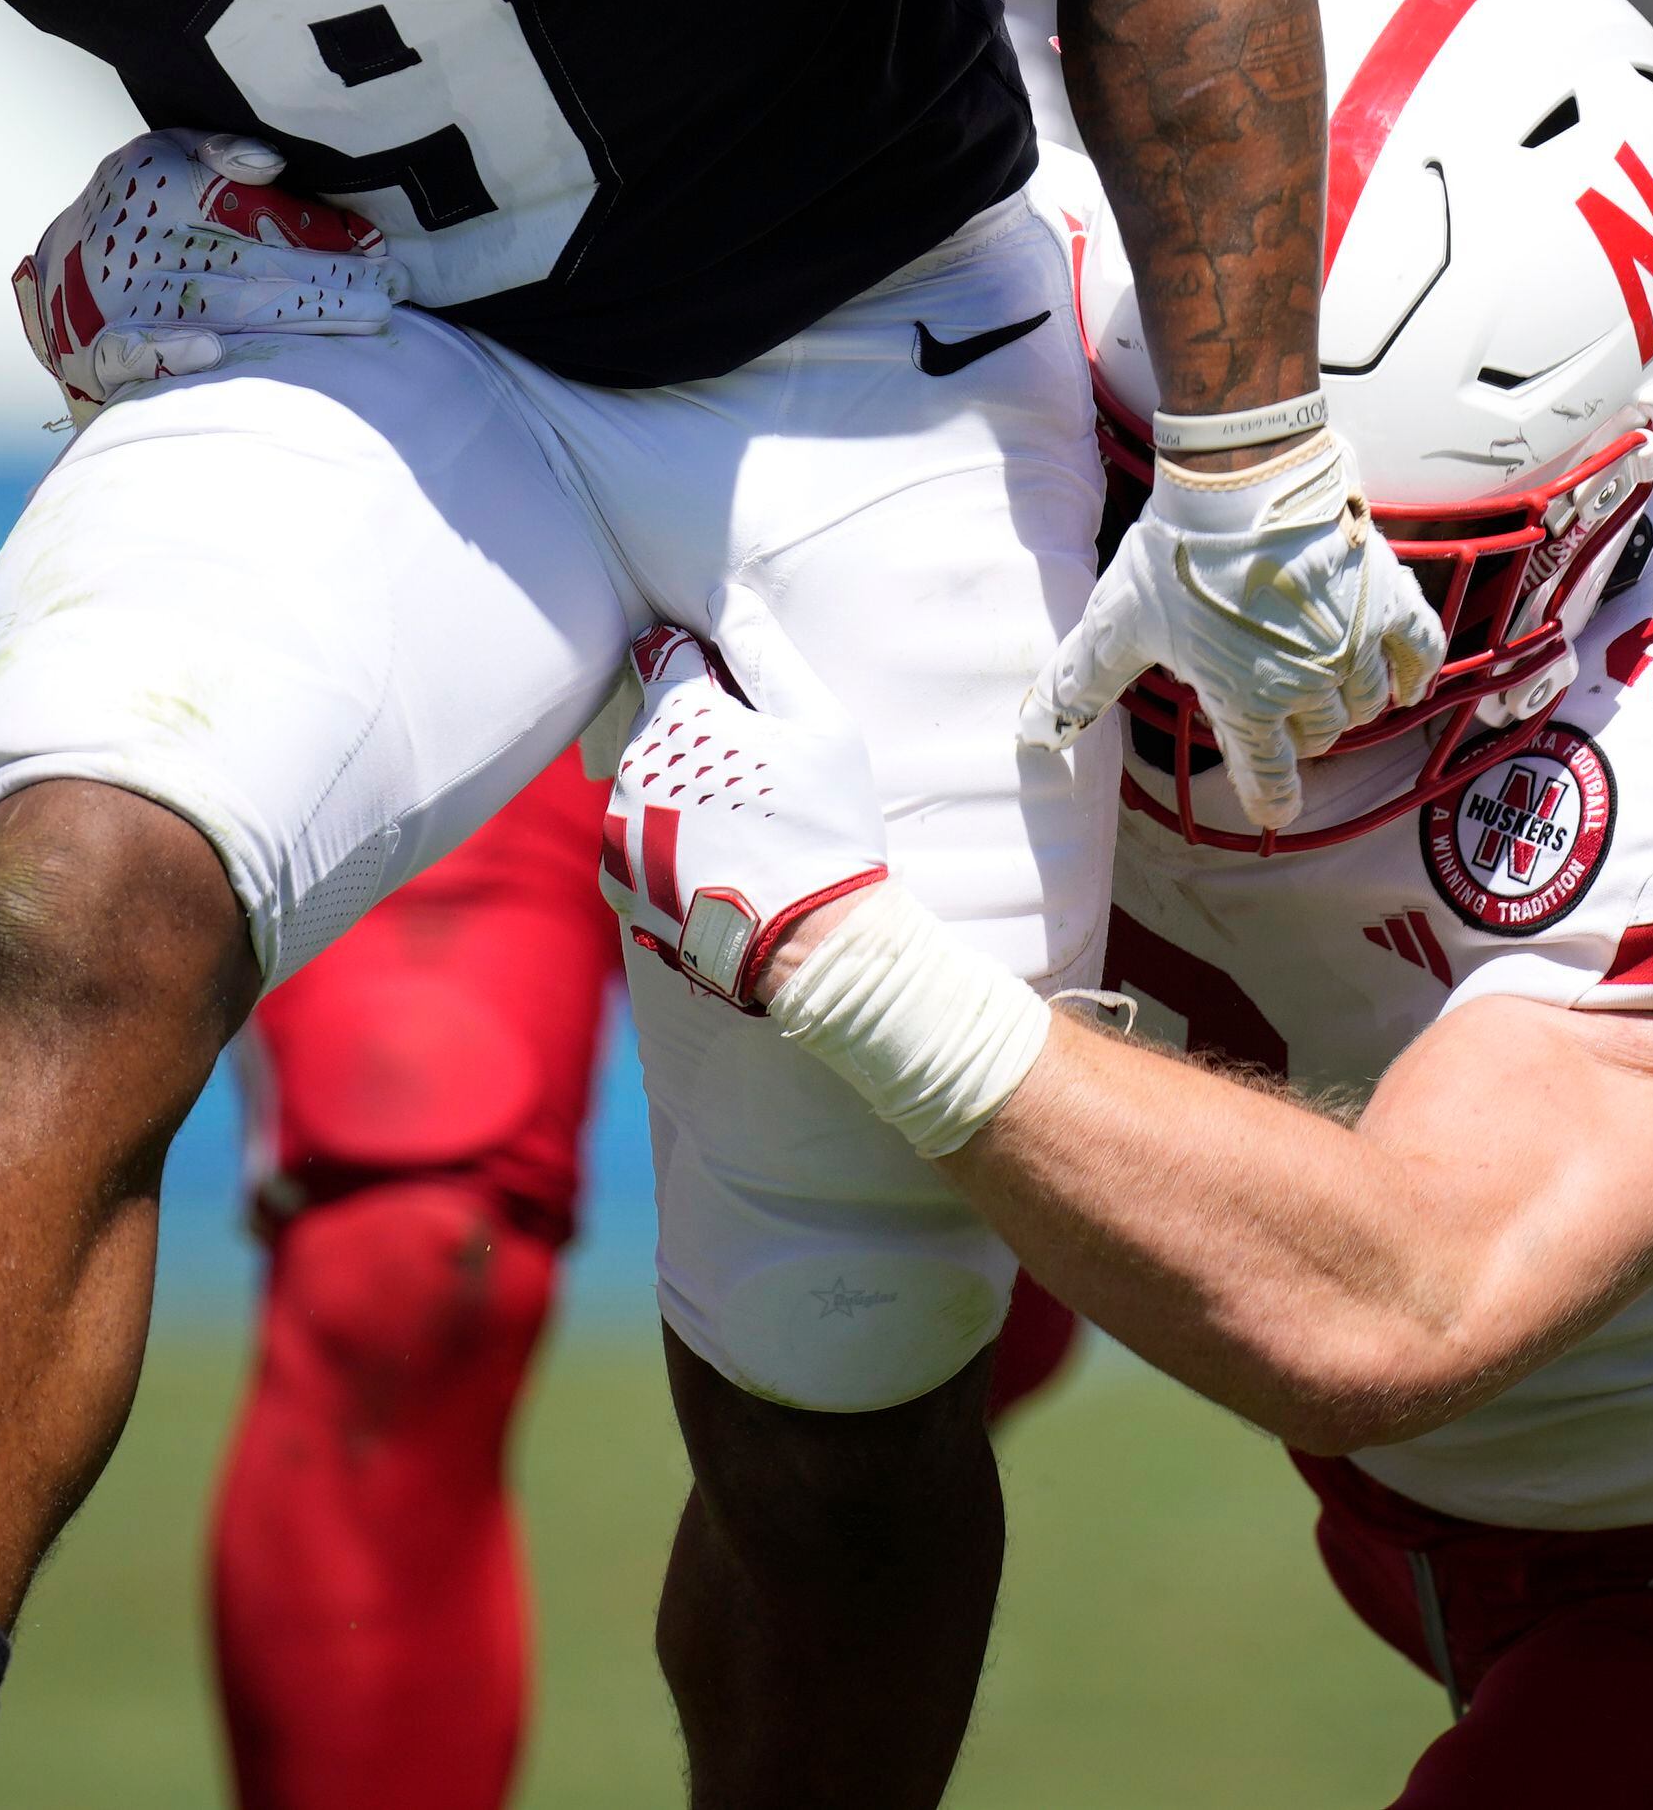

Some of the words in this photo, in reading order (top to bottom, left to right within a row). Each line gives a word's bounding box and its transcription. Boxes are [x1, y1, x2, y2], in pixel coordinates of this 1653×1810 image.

[1432, 806, 1450, 822] A
[1563, 743, 1604, 834] FOOTBALL
[1466, 793, 1569, 853] HUSKERS
[1432, 834, 1488, 917] WINNING
[1497, 858, 1587, 924] TRADITION
